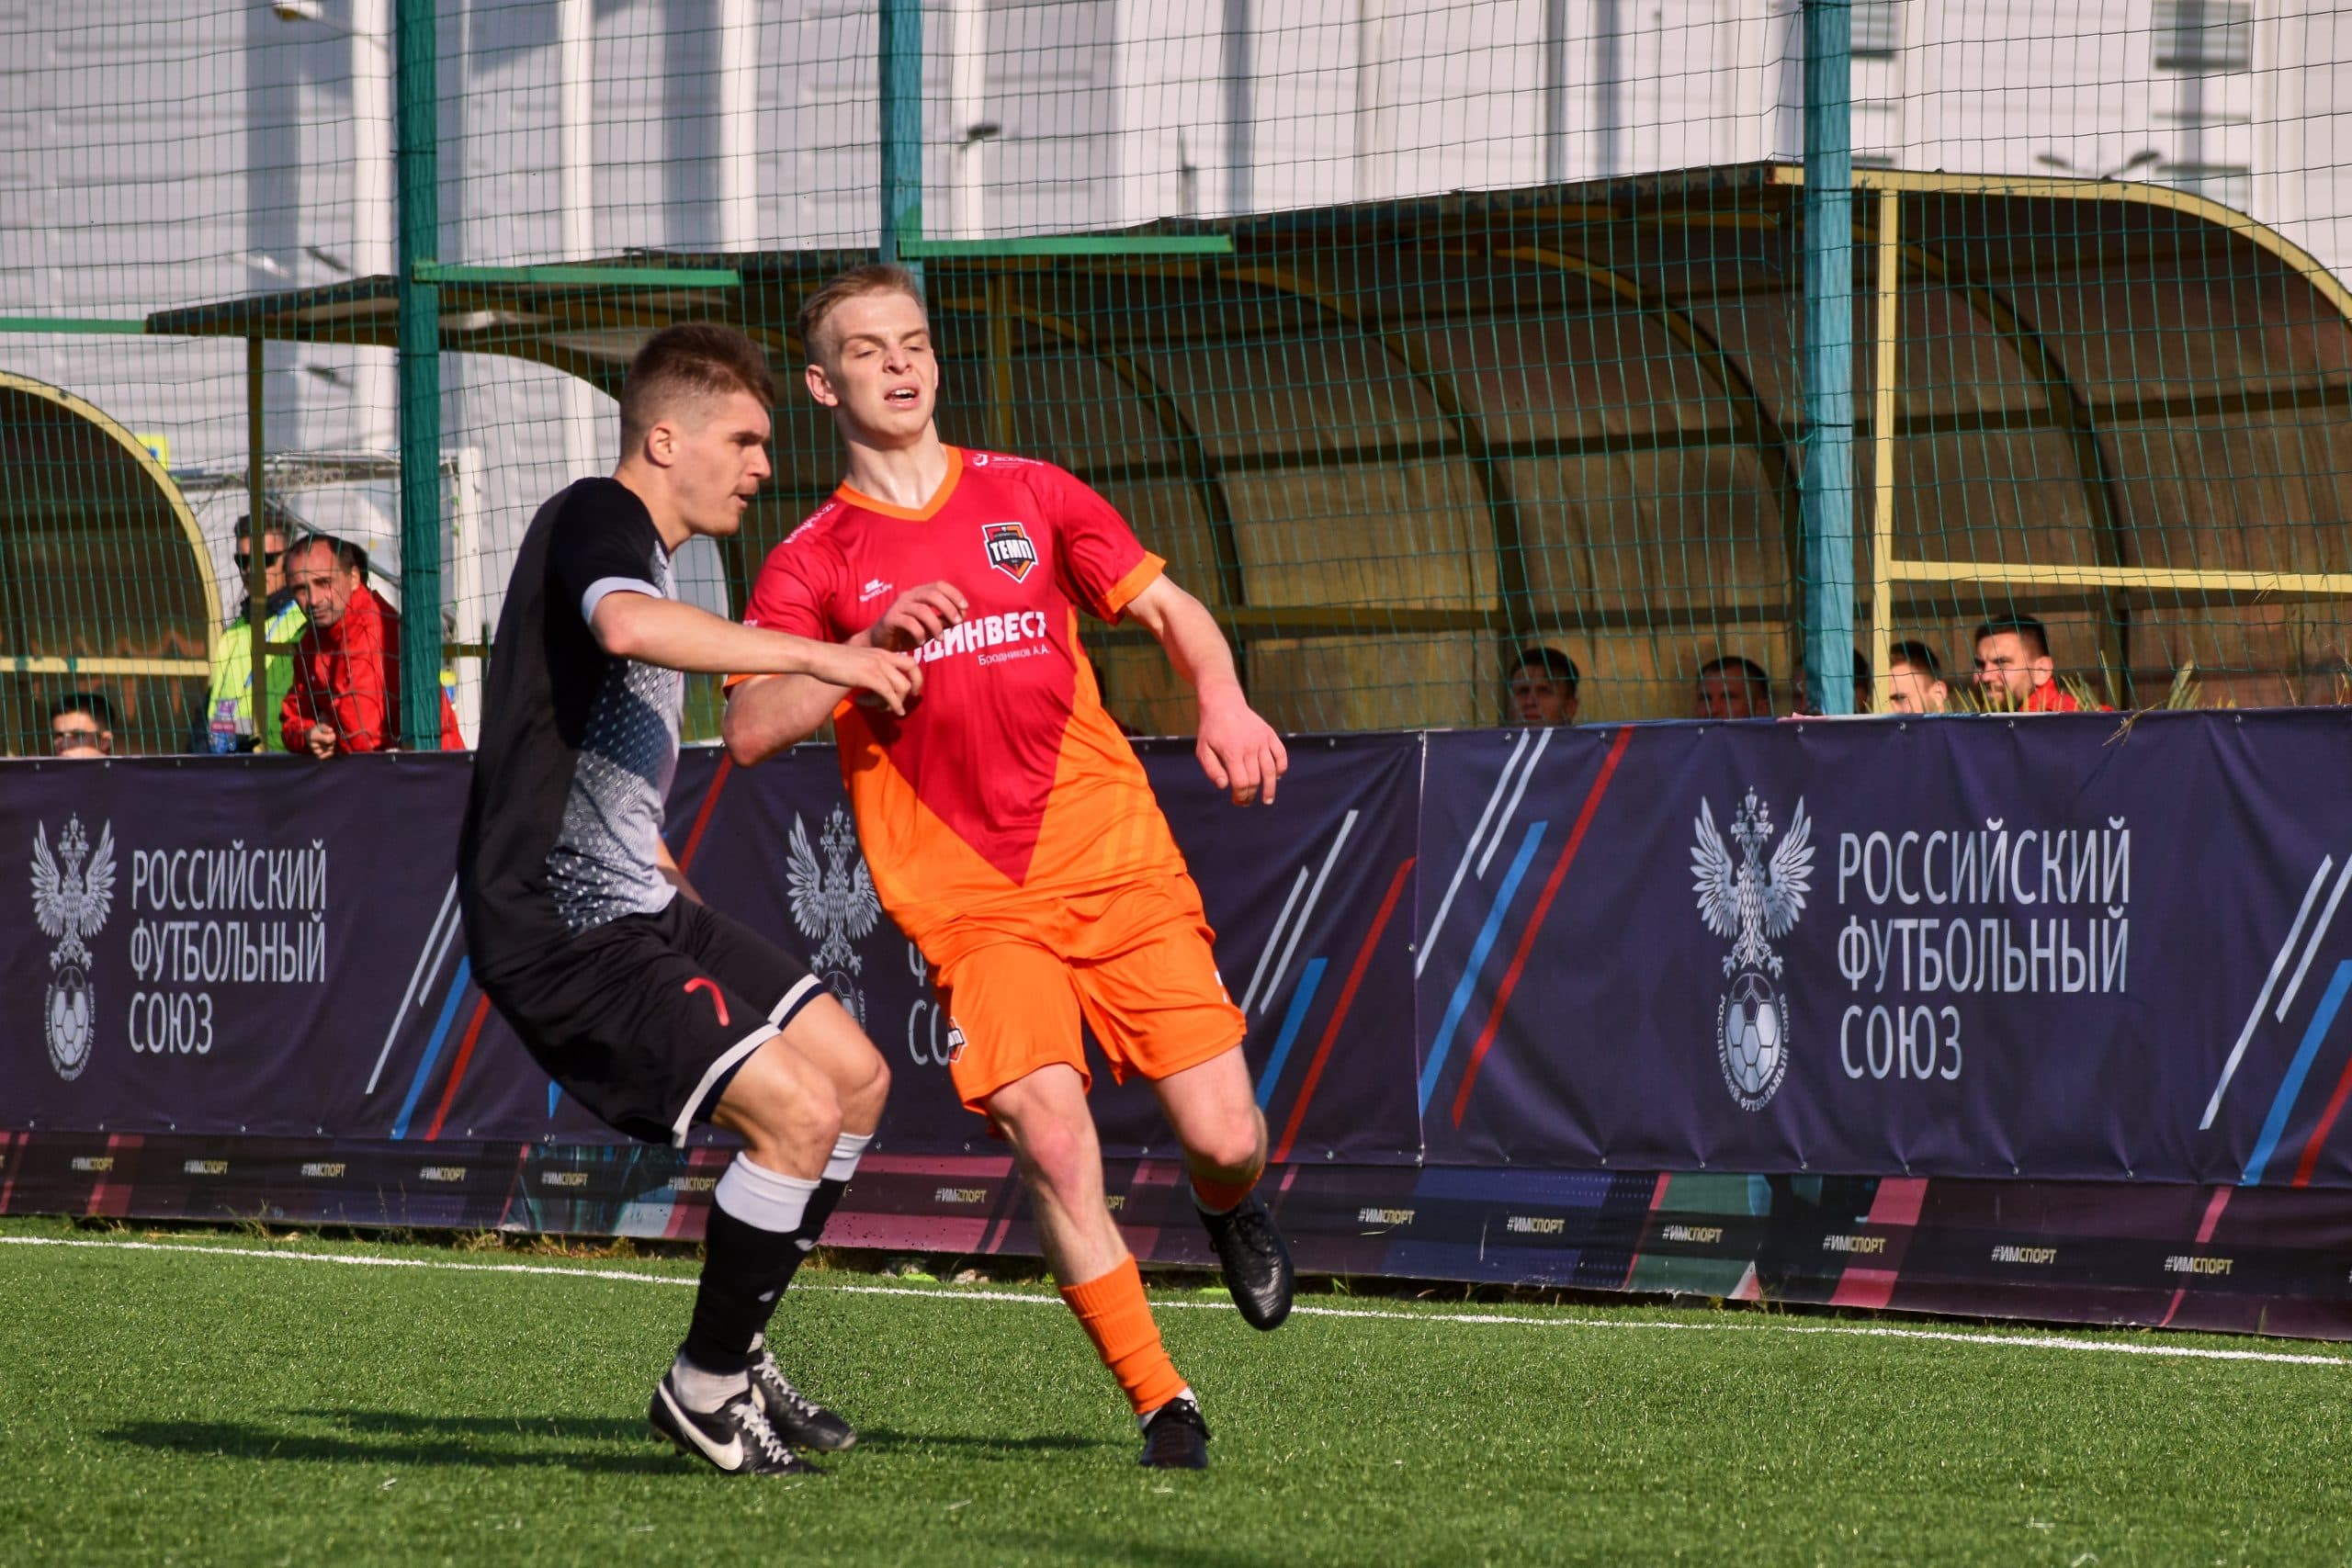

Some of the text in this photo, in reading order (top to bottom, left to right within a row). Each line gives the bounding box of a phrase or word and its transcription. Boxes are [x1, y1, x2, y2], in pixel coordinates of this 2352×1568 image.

[989, 539, 1034, 561] ТЕМП
[897, 611, 1046, 665] ДИНВЕСТ
[131, 839, 326, 911] РОССИЙСКИЙ
[1838, 816, 2131, 906] РОССИЙСКИЙ
[130, 911, 325, 983] ФУТБОЛЬНЫЙ
[1838, 905, 2129, 993] ФУТБОЛЬНЫЙ
[129, 991, 213, 1055] СОЮЗ
[908, 998, 951, 1066] СО
[1840, 1005, 1962, 1080] СОЮЗ
[934, 1188, 987, 1203] #ИМСПОРТ
[1357, 1208, 1416, 1224] #ИМСПОРТ
[1506, 1216, 1565, 1234] #ИМСПОРТ
[1662, 1224, 1723, 1244] #ИМСПОРТ
[1822, 1235, 1886, 1254] #ИМСПОРТ
[1991, 1246, 2057, 1265] #ИМСПОРТ
[2164, 1256, 2233, 1275] #ИМСПОРТ
